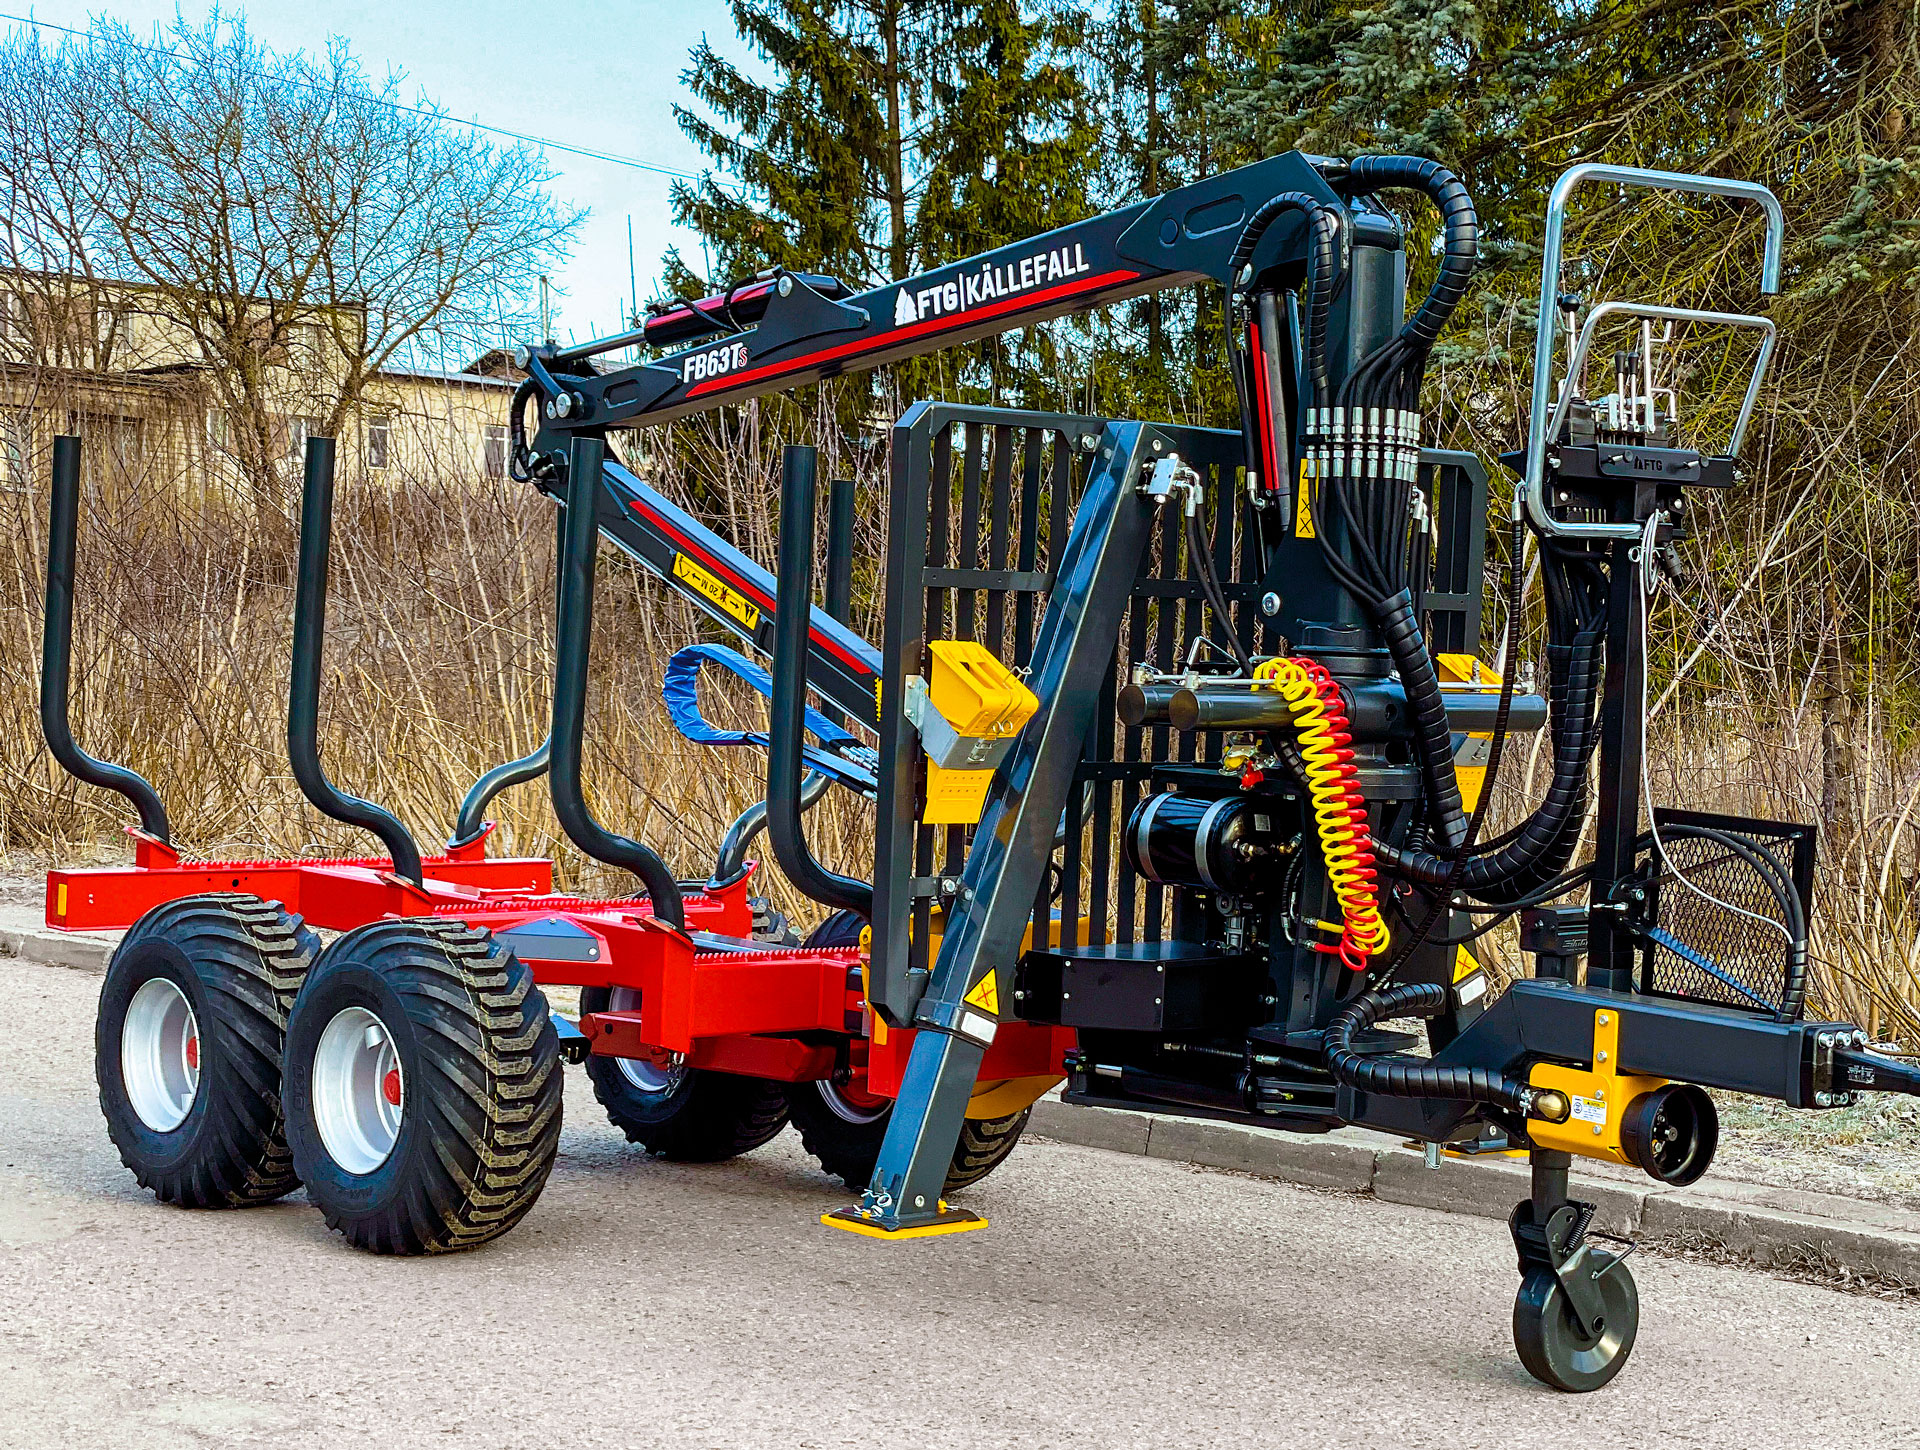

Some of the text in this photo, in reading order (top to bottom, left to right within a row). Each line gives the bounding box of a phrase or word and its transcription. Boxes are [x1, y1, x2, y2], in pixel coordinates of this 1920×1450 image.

[916, 242, 1090, 320] FTG KÄLLEFALL
[1644, 459, 1663, 471] FTG
[701, 578, 719, 596] 20 M
